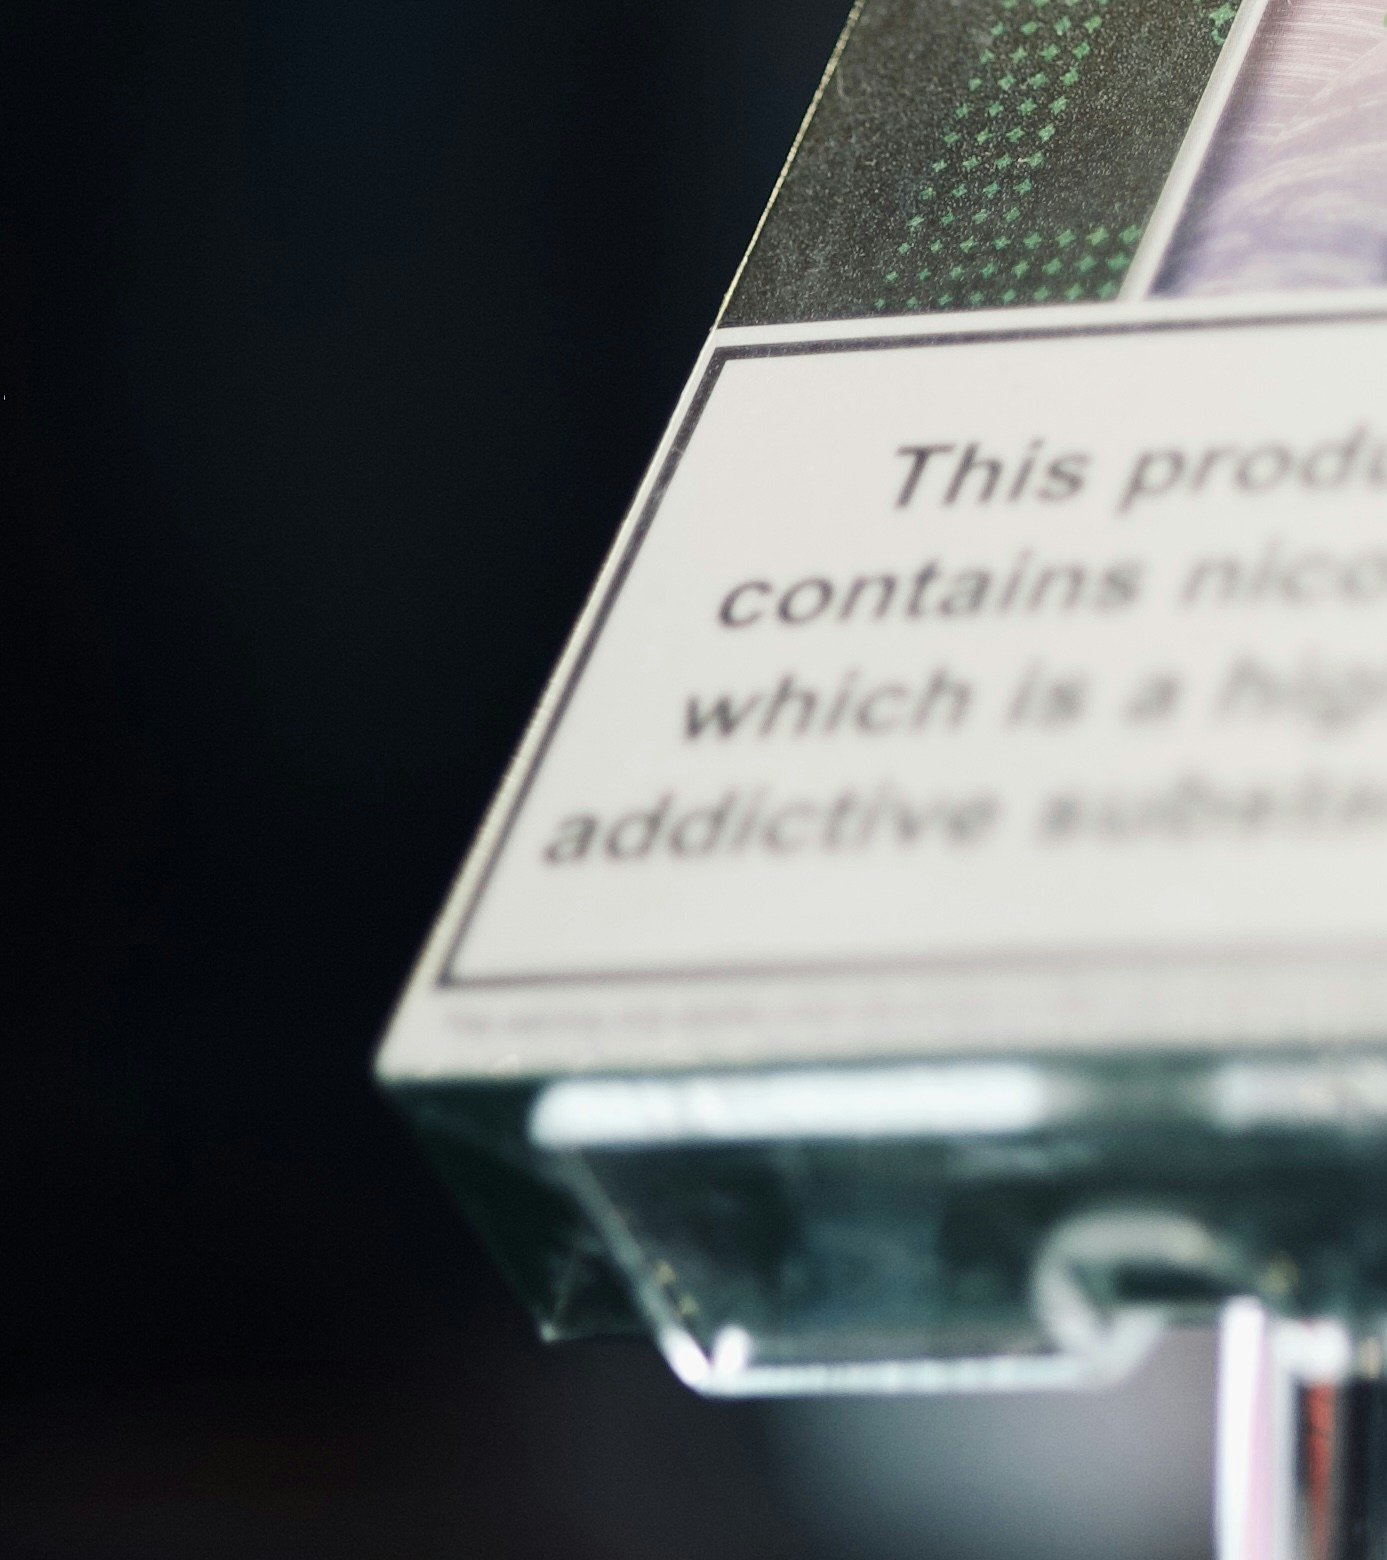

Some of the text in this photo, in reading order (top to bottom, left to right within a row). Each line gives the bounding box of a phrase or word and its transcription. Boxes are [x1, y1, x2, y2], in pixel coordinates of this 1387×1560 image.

[892, 436, 1096, 512] This
[714, 544, 1144, 632] contains
[682, 665, 976, 746] which
[1004, 655, 1092, 735] is
[1120, 670, 1186, 730] a
[540, 782, 1004, 868] addictive
